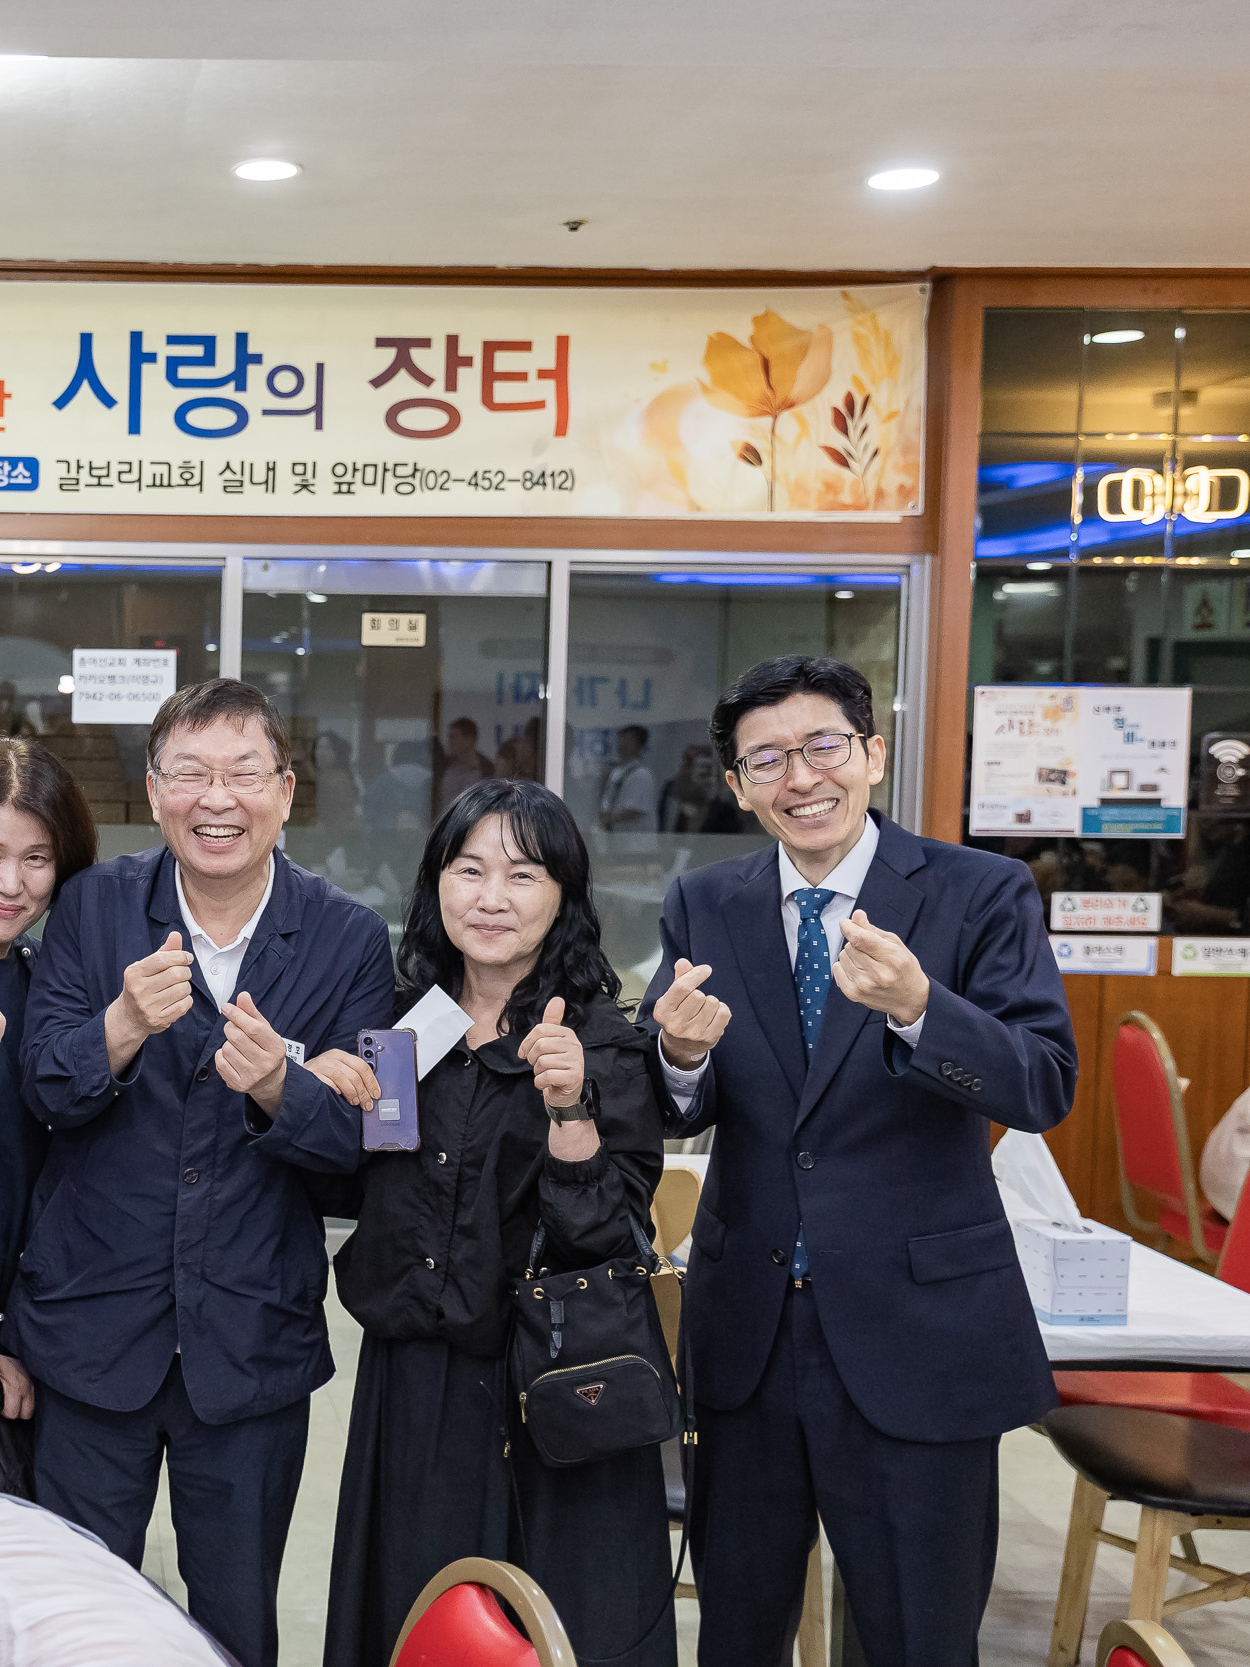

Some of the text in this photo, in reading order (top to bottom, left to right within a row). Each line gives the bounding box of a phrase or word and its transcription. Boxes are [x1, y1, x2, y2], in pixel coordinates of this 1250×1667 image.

[52, 330, 571, 440] 사랑의 장터
[55, 458, 576, 496] 갈보리교회 실내 및 앞마당(02-452-8412)
[369, 617, 419, 632] 회의실
